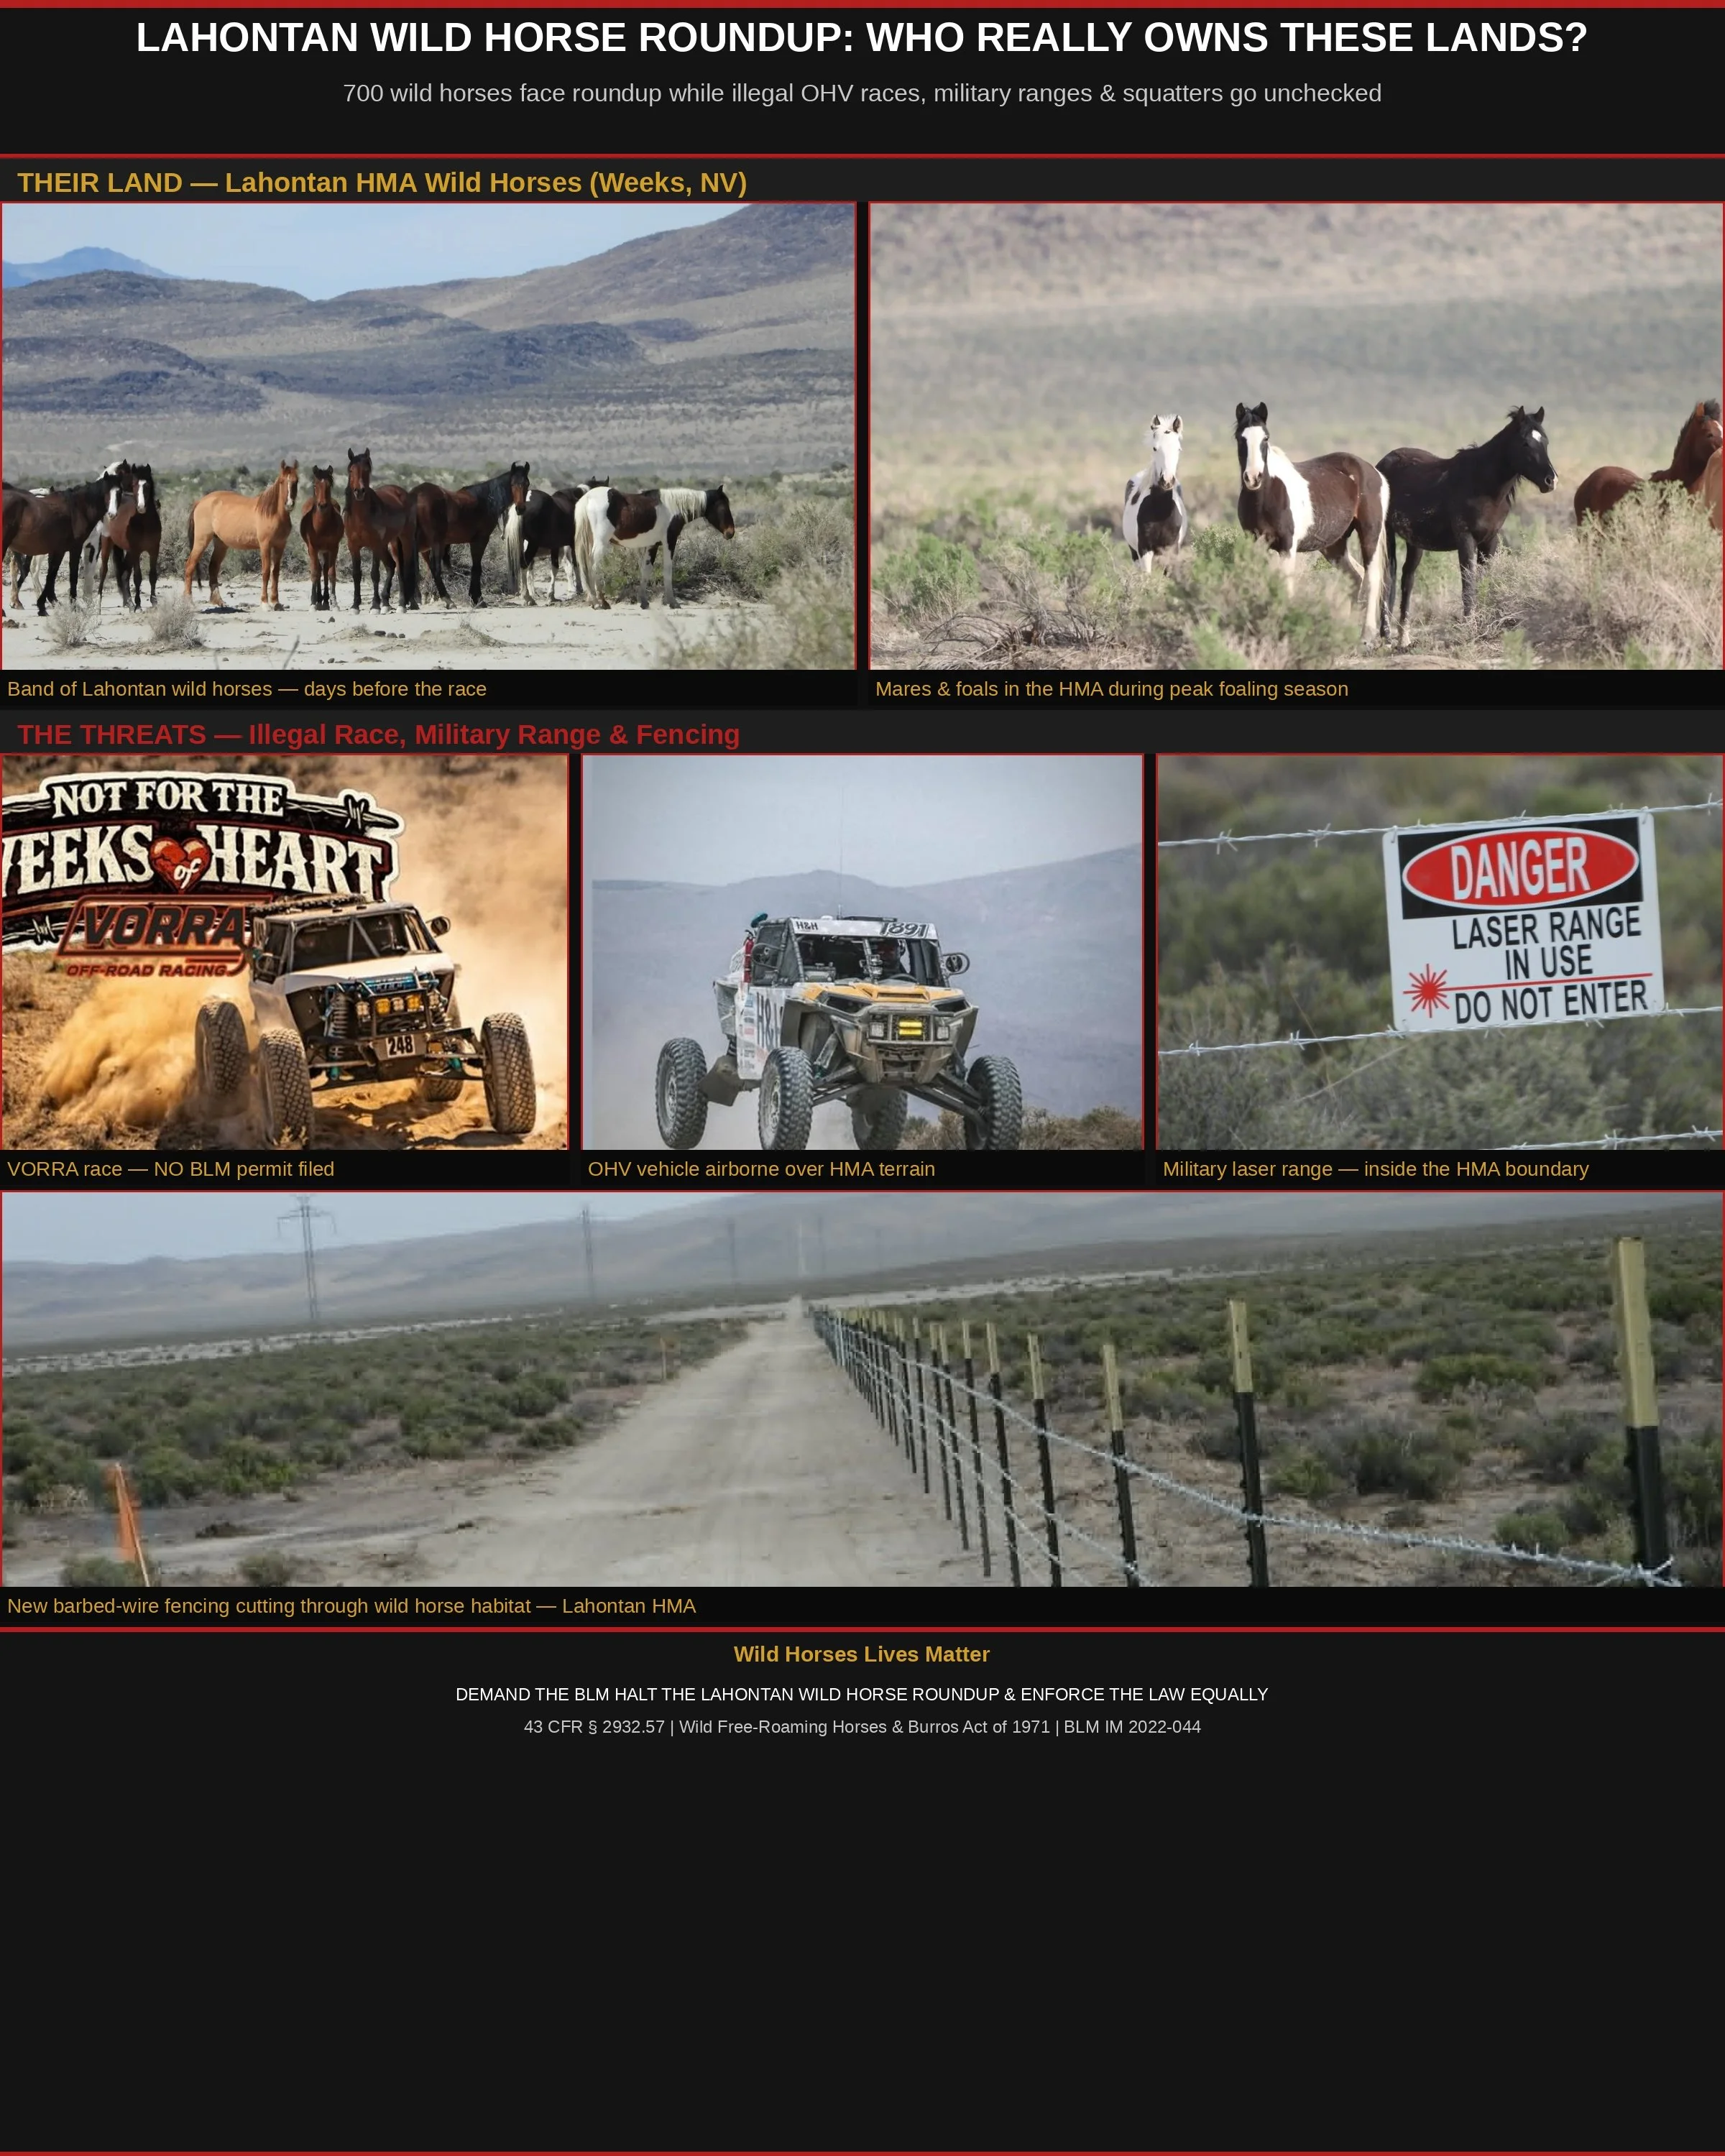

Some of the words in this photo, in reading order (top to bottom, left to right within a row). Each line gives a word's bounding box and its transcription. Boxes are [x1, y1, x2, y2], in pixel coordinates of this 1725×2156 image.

[1450, 837, 1591, 900] DANGER
[796, 921, 818, 931] H&H
[879, 921, 929, 939] 1891
[1452, 913, 1539, 949] LASER
[1550, 906, 1642, 943] RANGE
[1505, 948, 1530, 980] IN
[1541, 944, 1593, 977] USE
[1455, 990, 1491, 1024] DO
[1501, 986, 1552, 1021] NOT
[1564, 980, 1649, 1016] ENTER
[387, 1035, 415, 1056] 248
